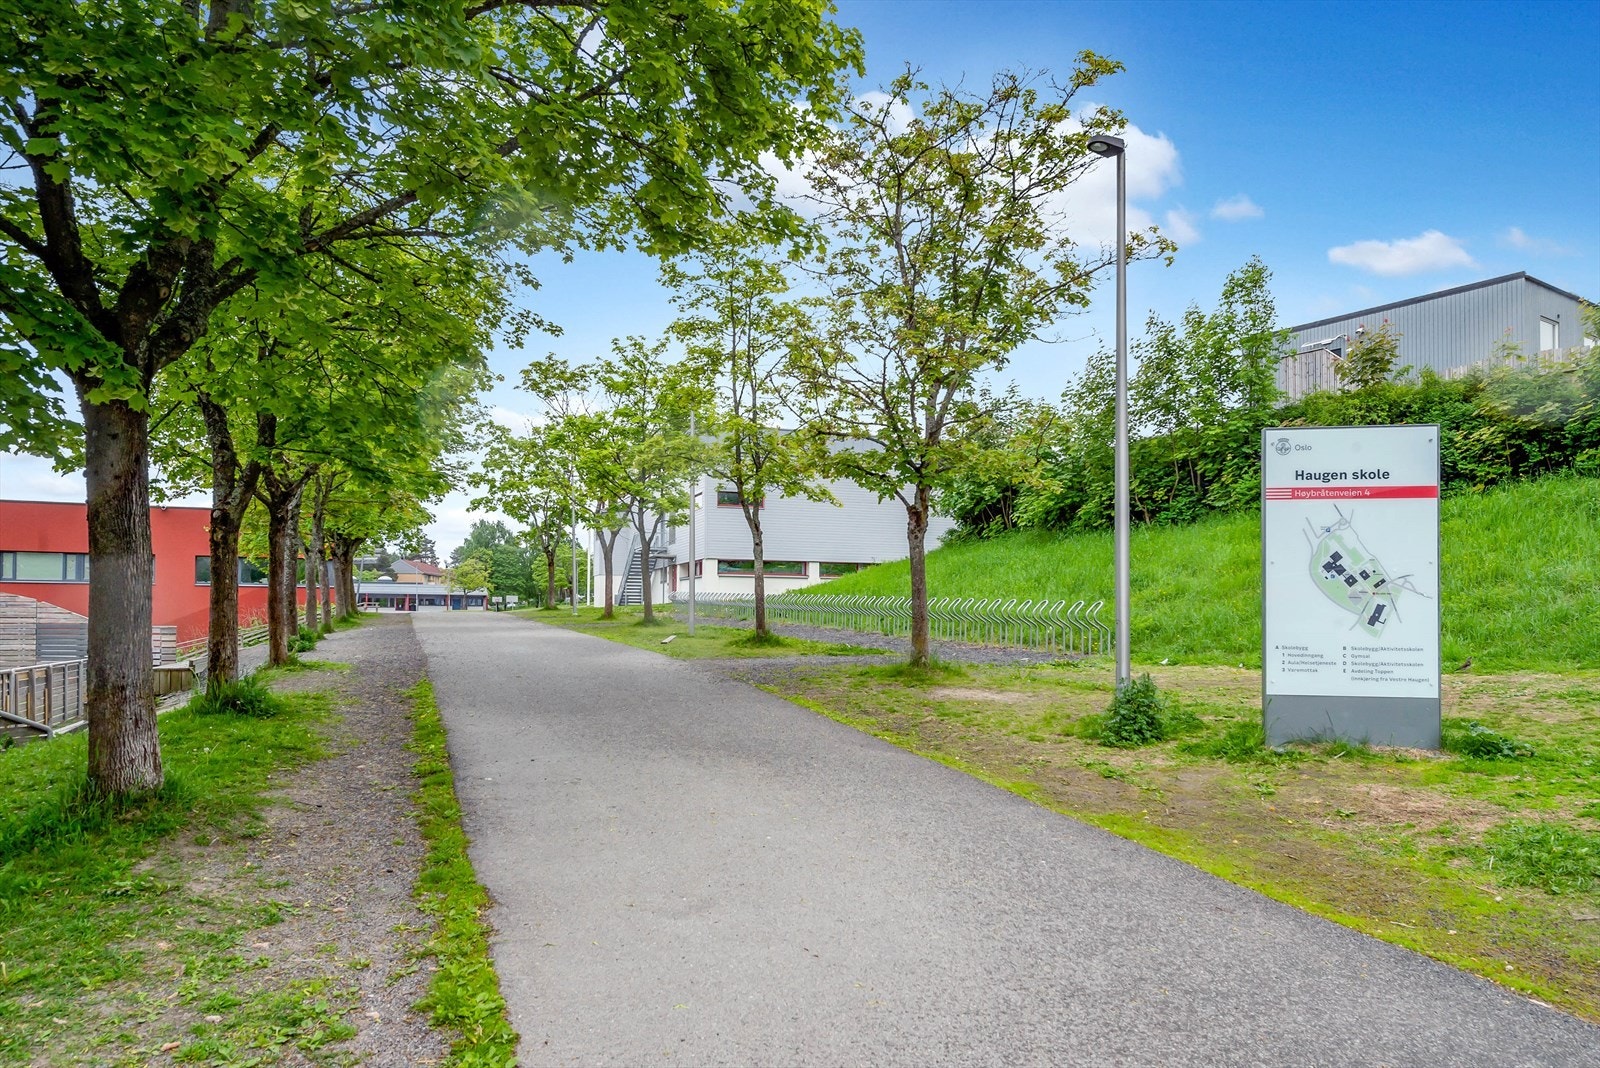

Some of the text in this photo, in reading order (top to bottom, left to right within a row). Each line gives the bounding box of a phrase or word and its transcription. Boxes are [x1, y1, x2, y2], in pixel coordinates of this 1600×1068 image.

[1295, 468, 1390, 483] Haugen skole
[1294, 488, 1362, 498] Høybråtenveien
